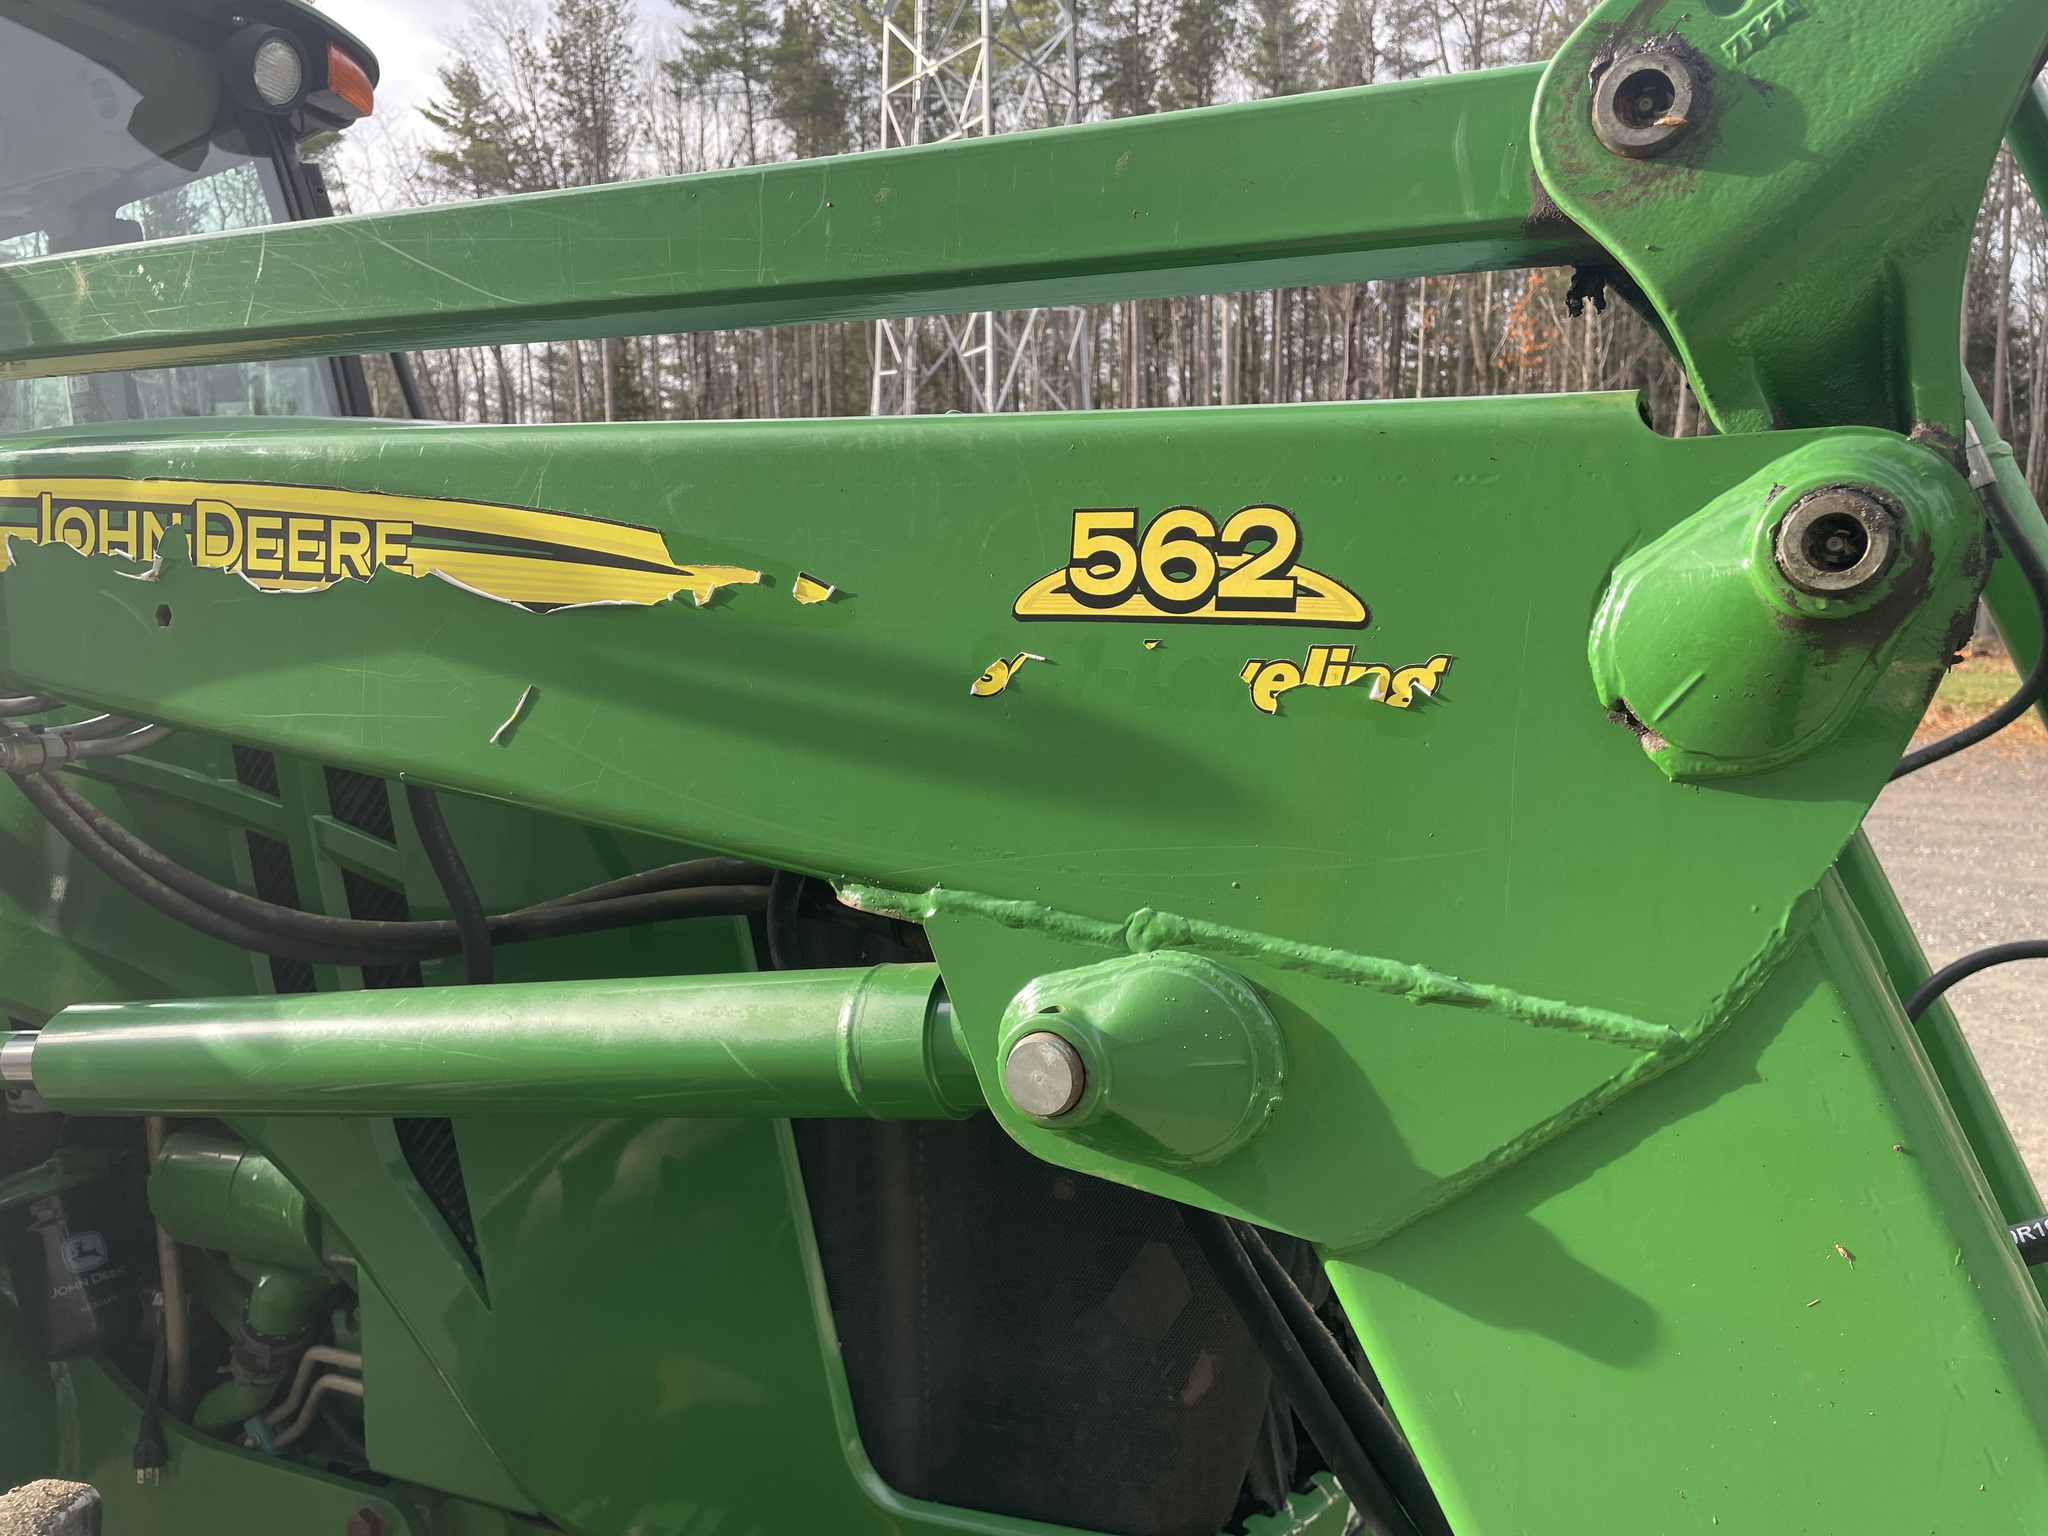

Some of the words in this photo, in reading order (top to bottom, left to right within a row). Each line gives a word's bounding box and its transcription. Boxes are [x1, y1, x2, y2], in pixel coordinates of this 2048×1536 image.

[41, 492, 182, 562] JOHN
[195, 499, 414, 577] DEERE
[1068, 505, 1301, 609] 562
[50, 1278, 90, 1301] JOHN
